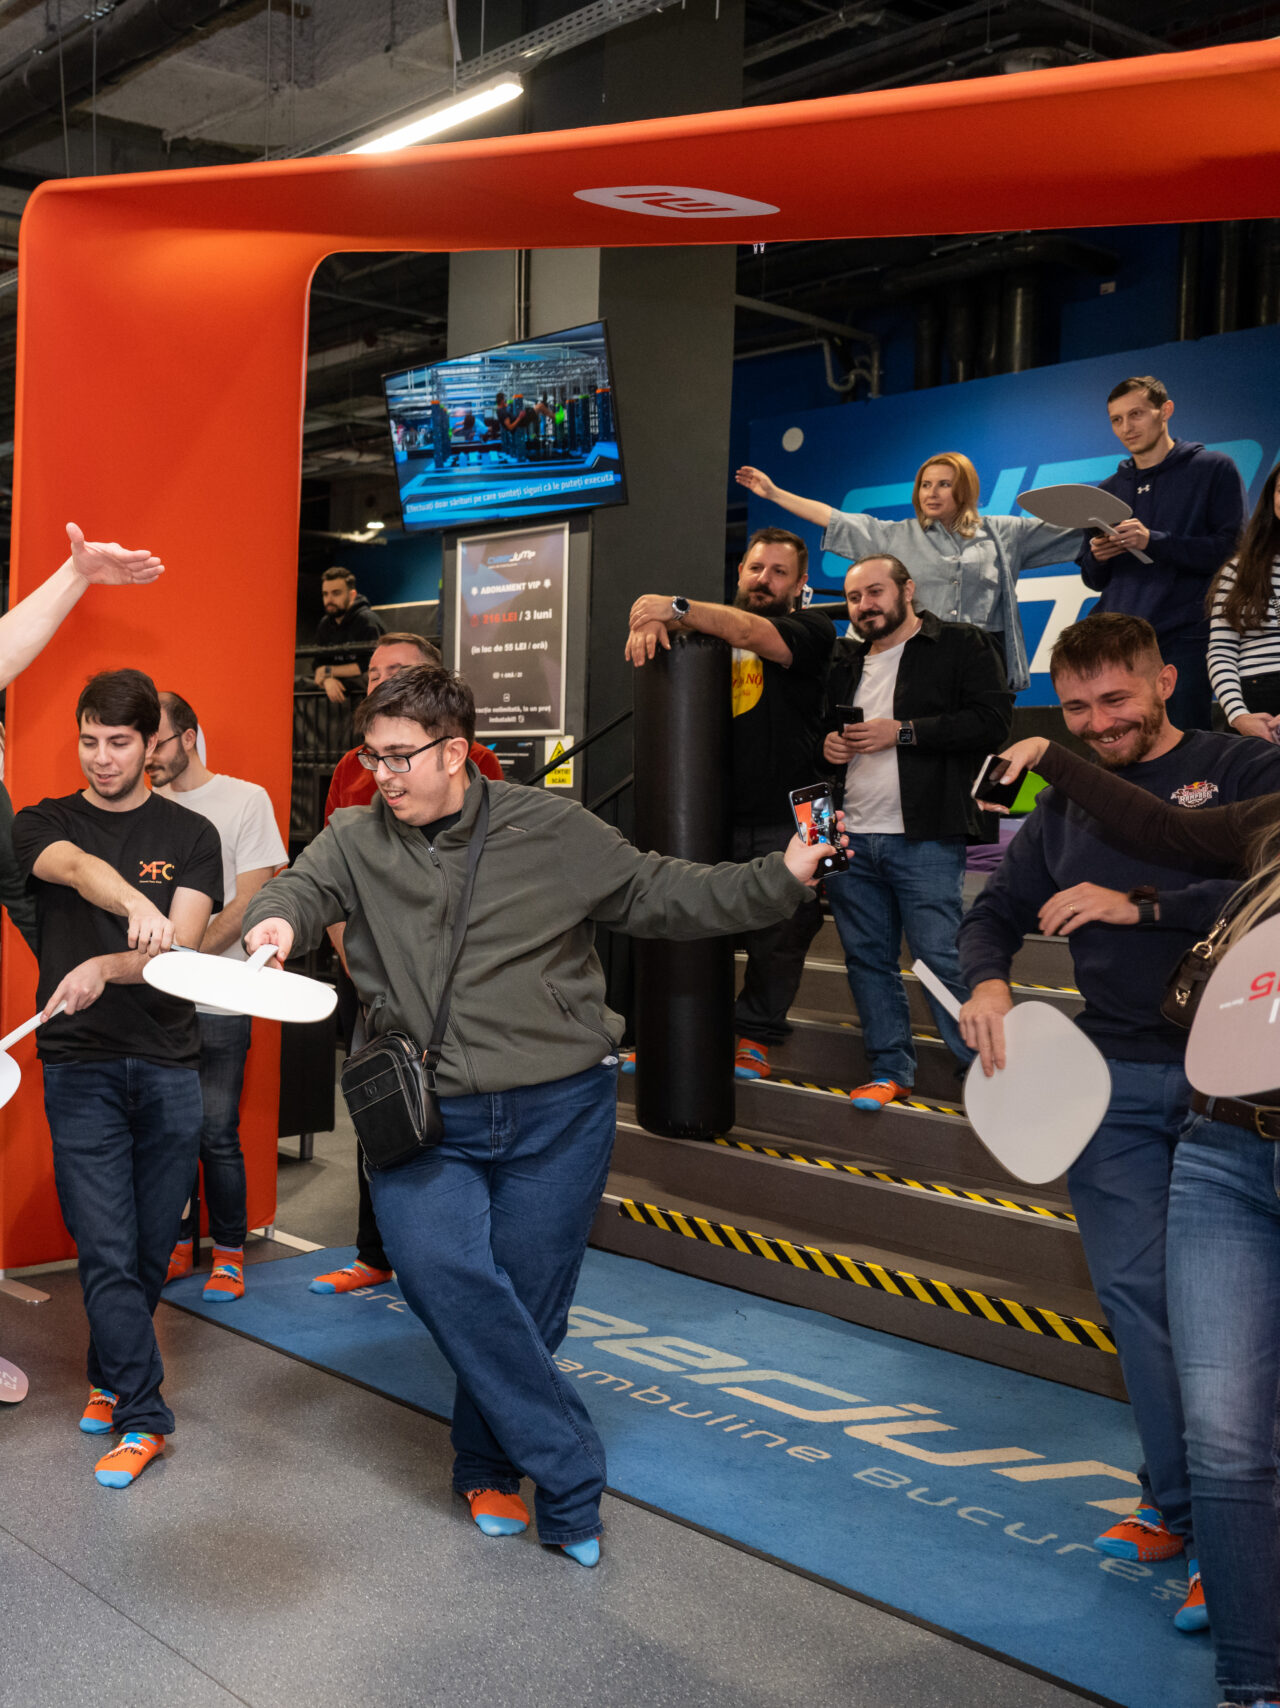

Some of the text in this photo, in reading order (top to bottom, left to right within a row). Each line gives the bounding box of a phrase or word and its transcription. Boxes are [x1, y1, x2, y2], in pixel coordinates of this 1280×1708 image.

[483, 493, 497, 502] care
[523, 485, 543, 497] siguri
[480, 580, 541, 594] ABONAMENT VIP
[502, 612, 518, 622] LEI
[524, 610, 532, 620] 3
[533, 608, 552, 619] luni
[494, 644, 503, 652] de
[515, 642, 527, 651] LEI
[552, 1354, 832, 1463] ambuline
